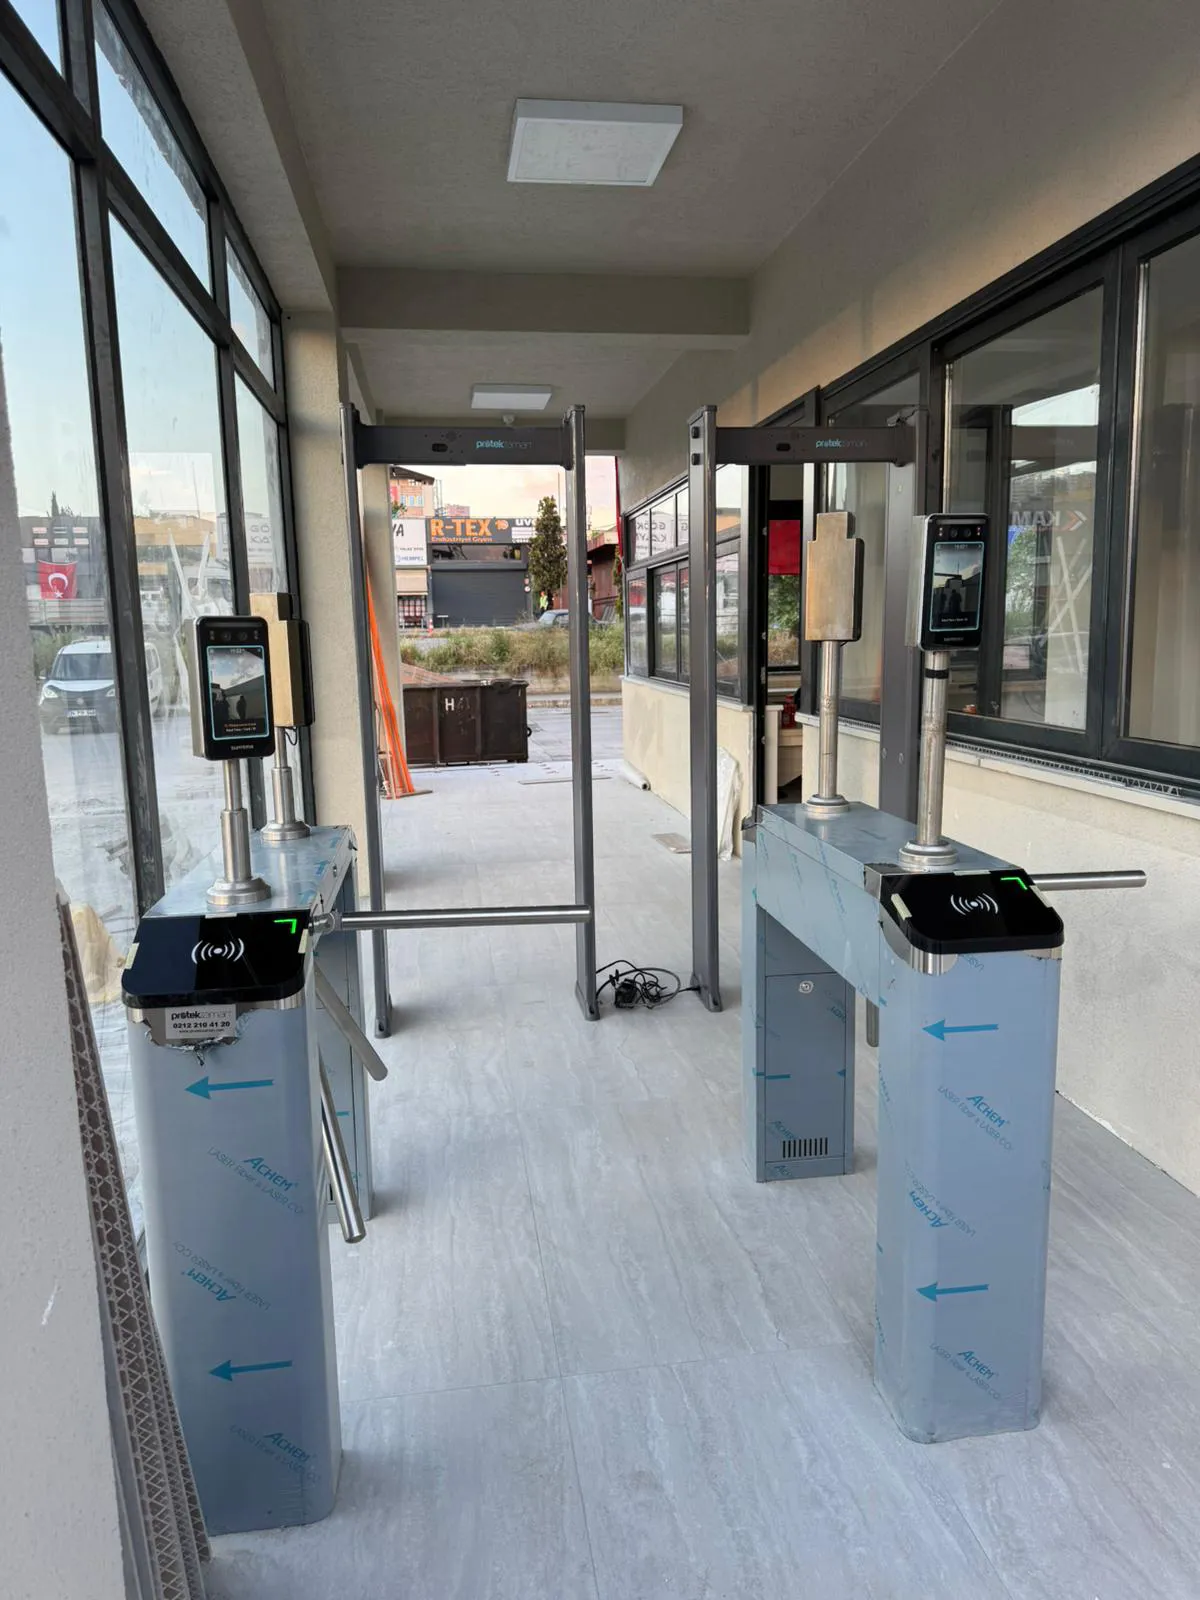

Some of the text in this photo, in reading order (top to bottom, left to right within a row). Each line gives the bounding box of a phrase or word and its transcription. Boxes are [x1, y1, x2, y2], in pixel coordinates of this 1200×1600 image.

[431, 518, 492, 537] R-TEX
[966, 1095, 1005, 1128] ACHEM
[207, 1146, 234, 1169] LASER
[242, 1156, 293, 1192] ACHEM
[909, 1190, 949, 1228] ACHEM
[187, 1267, 236, 1302] ACHEM
